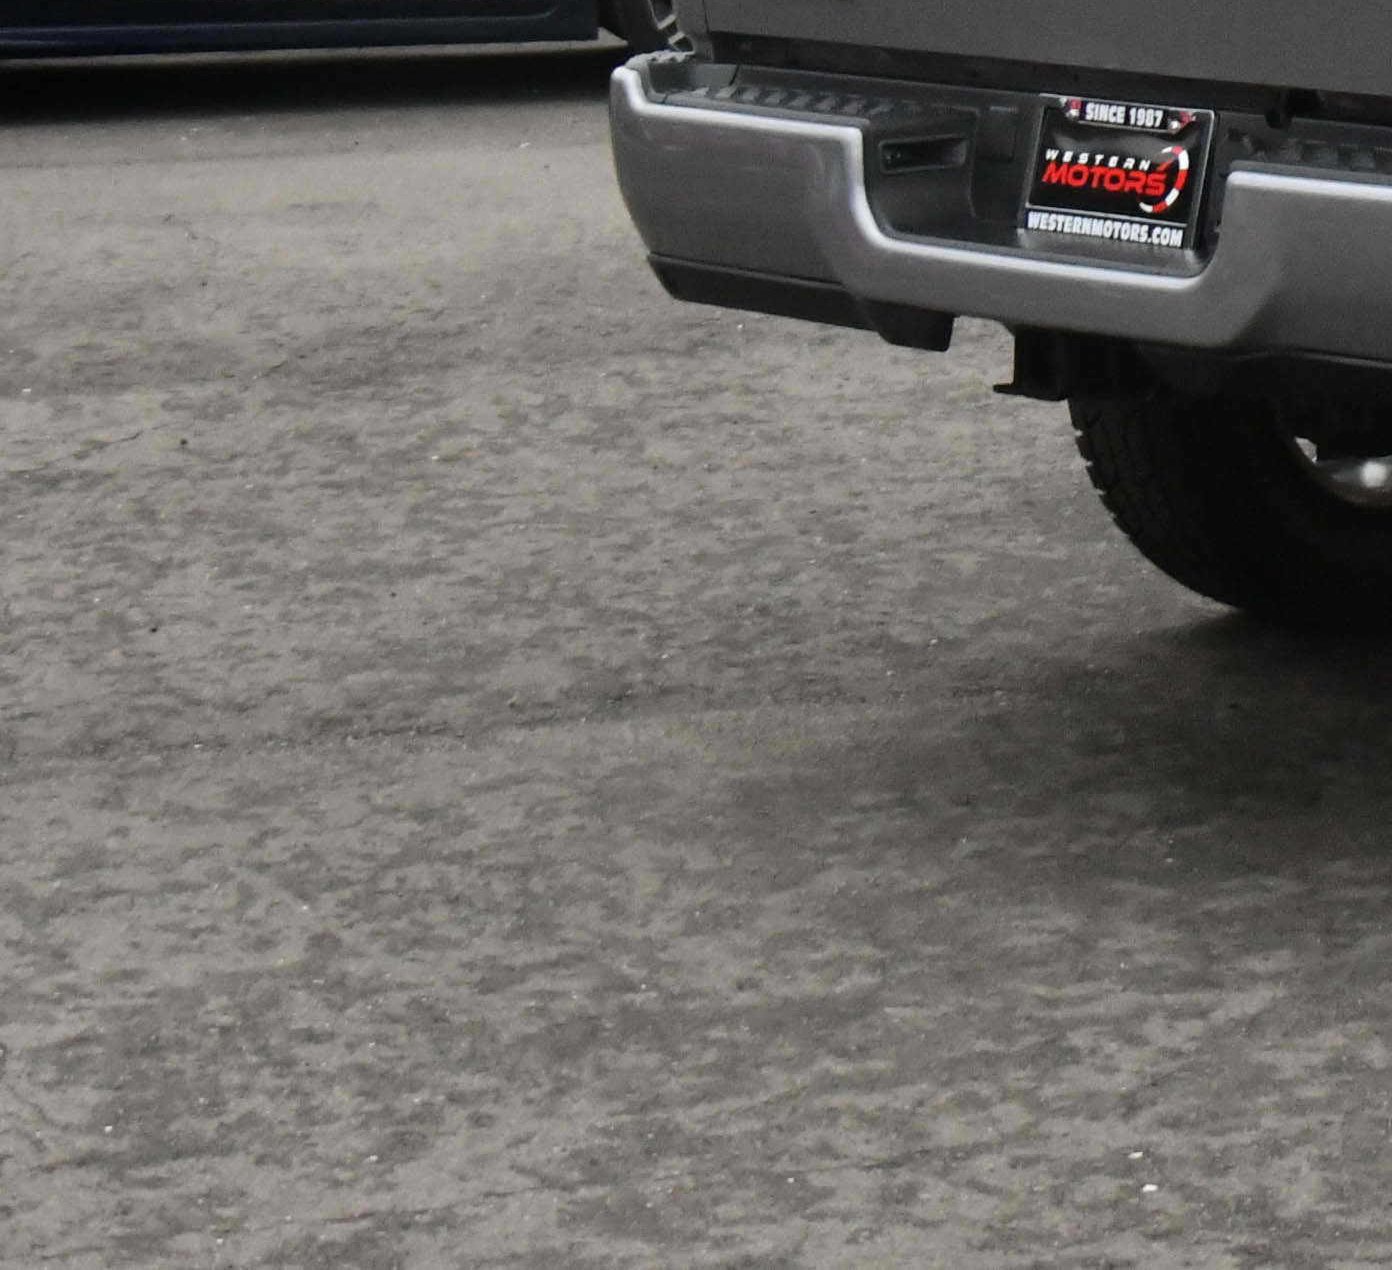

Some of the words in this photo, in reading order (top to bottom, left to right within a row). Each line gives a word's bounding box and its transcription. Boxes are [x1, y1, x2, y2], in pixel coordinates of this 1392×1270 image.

[1085, 102, 1125, 124] SINCE
[1130, 107, 1164, 128] 1987
[1045, 148, 1151, 171] WESTERN
[1042, 161, 1167, 197] MOTORS
[1027, 211, 1184, 248] WESTERNMOTORS.COM
